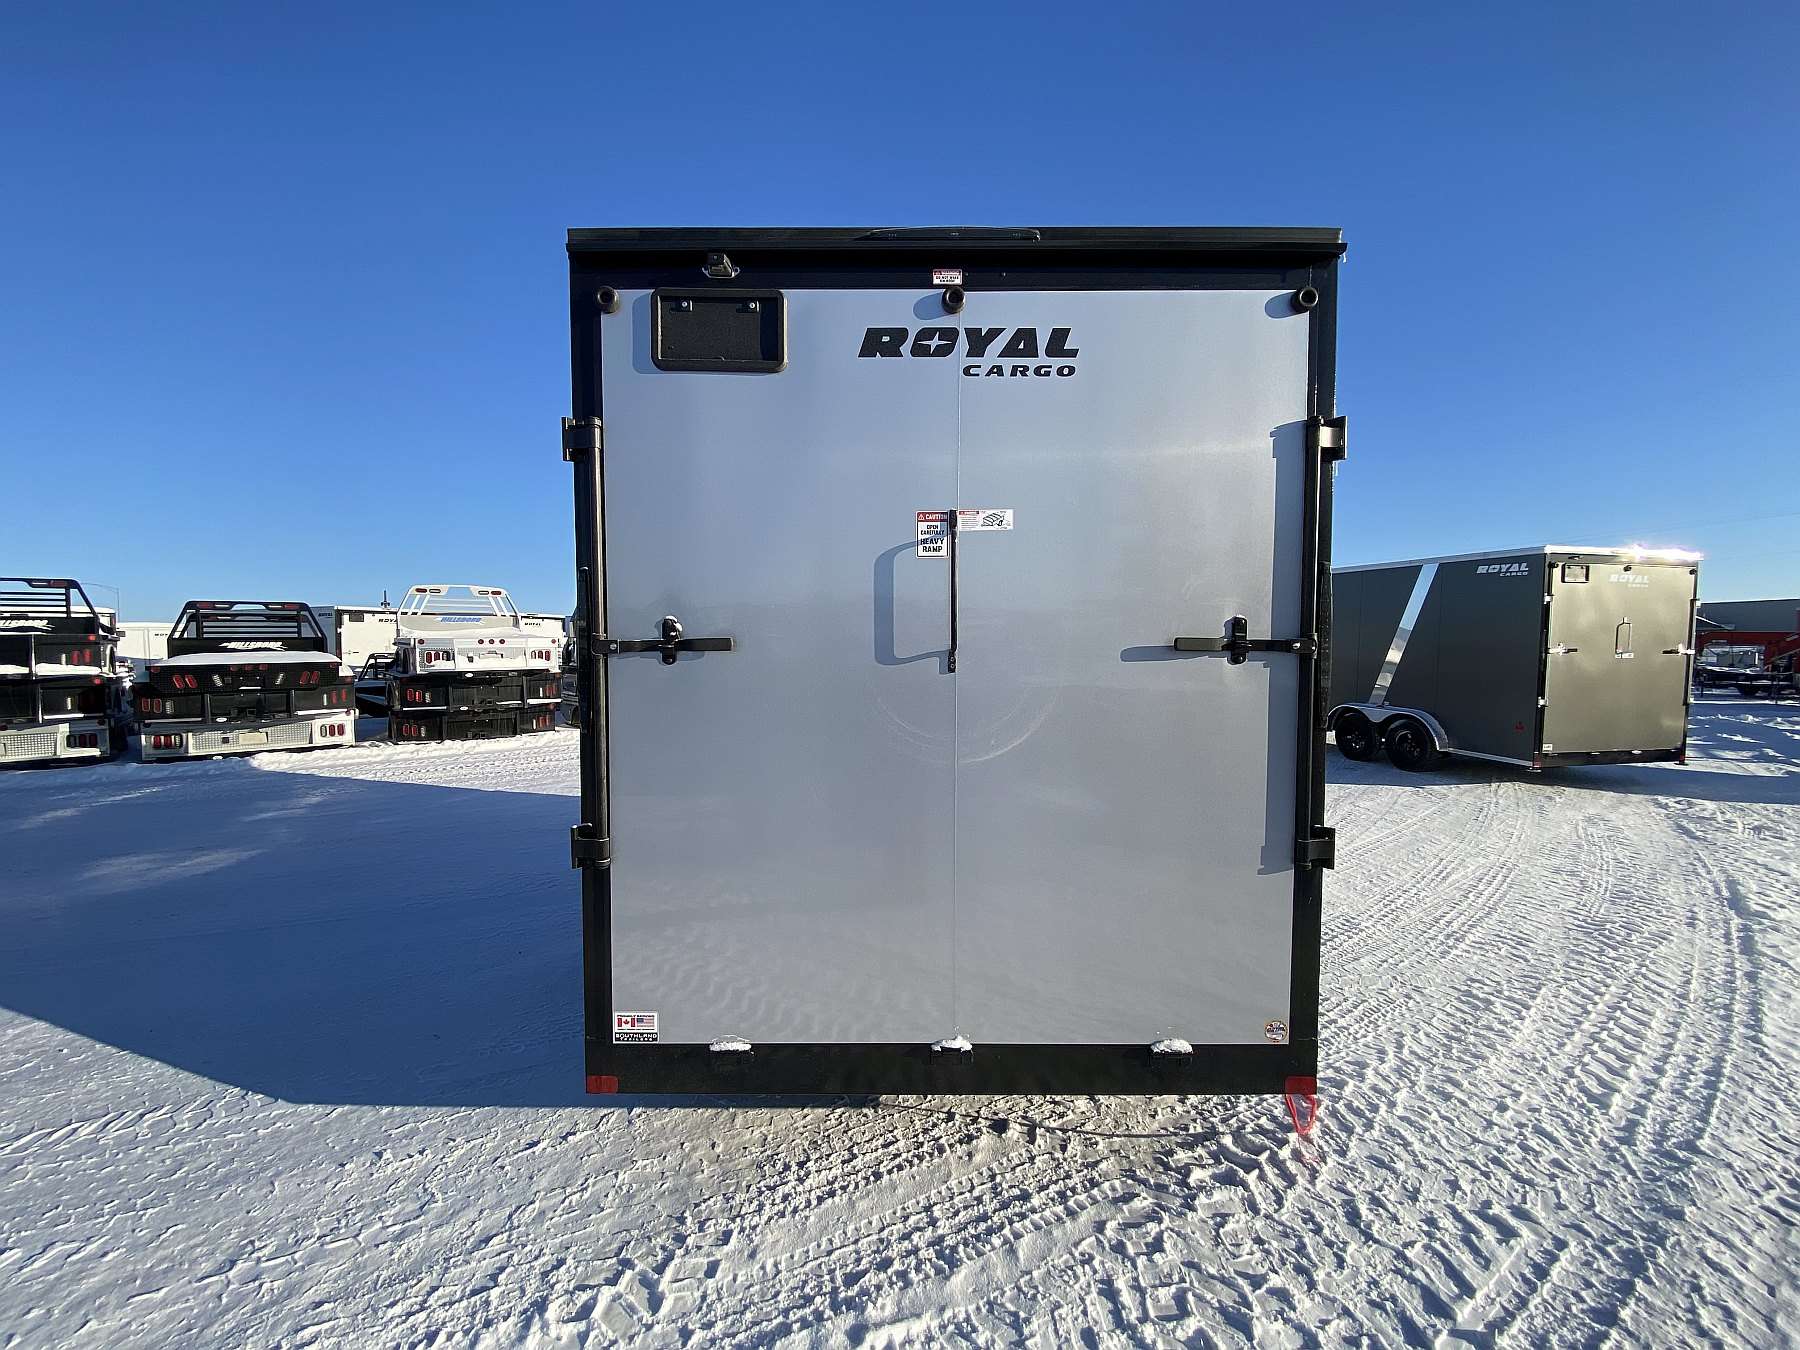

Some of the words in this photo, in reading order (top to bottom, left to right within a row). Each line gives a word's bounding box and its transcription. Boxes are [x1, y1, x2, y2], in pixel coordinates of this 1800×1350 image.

[858, 327, 1080, 358] ROYAL
[962, 364, 1077, 377] CARGO
[920, 537, 945, 545] HEAVY
[922, 545, 943, 553] RAMP
[1476, 562, 1529, 574] ROYAL
[1609, 574, 1649, 583] ROYAL
